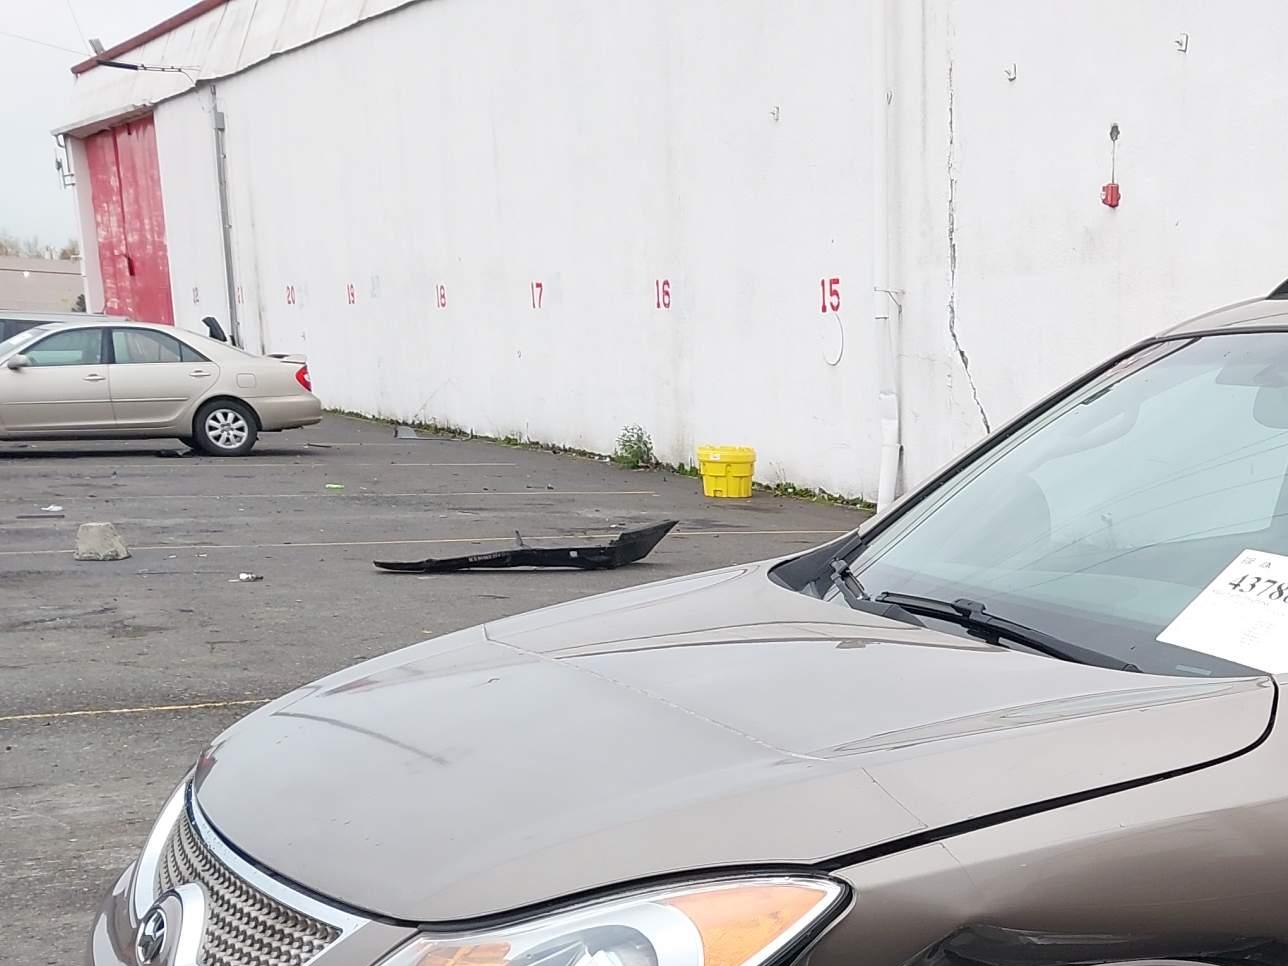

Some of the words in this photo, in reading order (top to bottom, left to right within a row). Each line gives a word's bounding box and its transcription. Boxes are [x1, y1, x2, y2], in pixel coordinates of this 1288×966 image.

[436, 284, 447, 308] 18
[531, 281, 543, 309] 17
[656, 279, 671, 309] 16
[821, 278, 840, 313] 15
